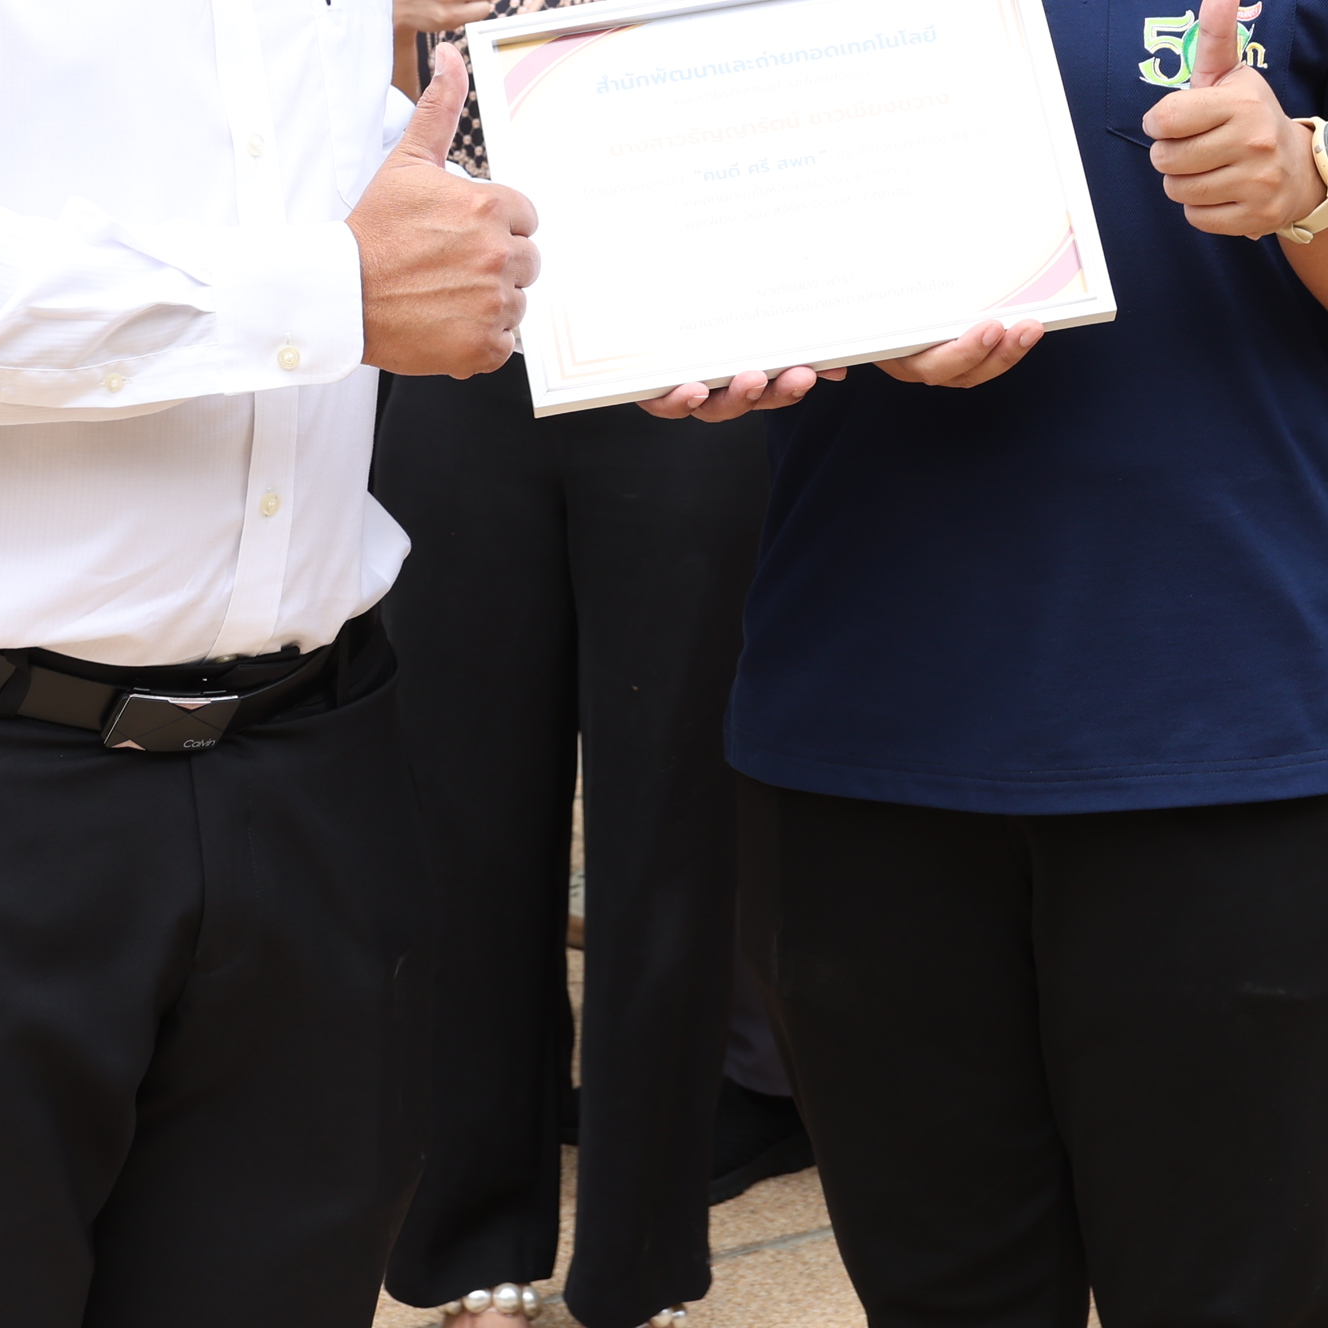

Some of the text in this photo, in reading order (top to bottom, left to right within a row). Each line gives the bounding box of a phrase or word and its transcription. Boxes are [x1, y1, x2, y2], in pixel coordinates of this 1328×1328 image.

[594, 23, 938, 95] สำนักพัฒนาและถ่ายทอดเทคโนโลยี
[183, 738, 216, 748] Calvin
